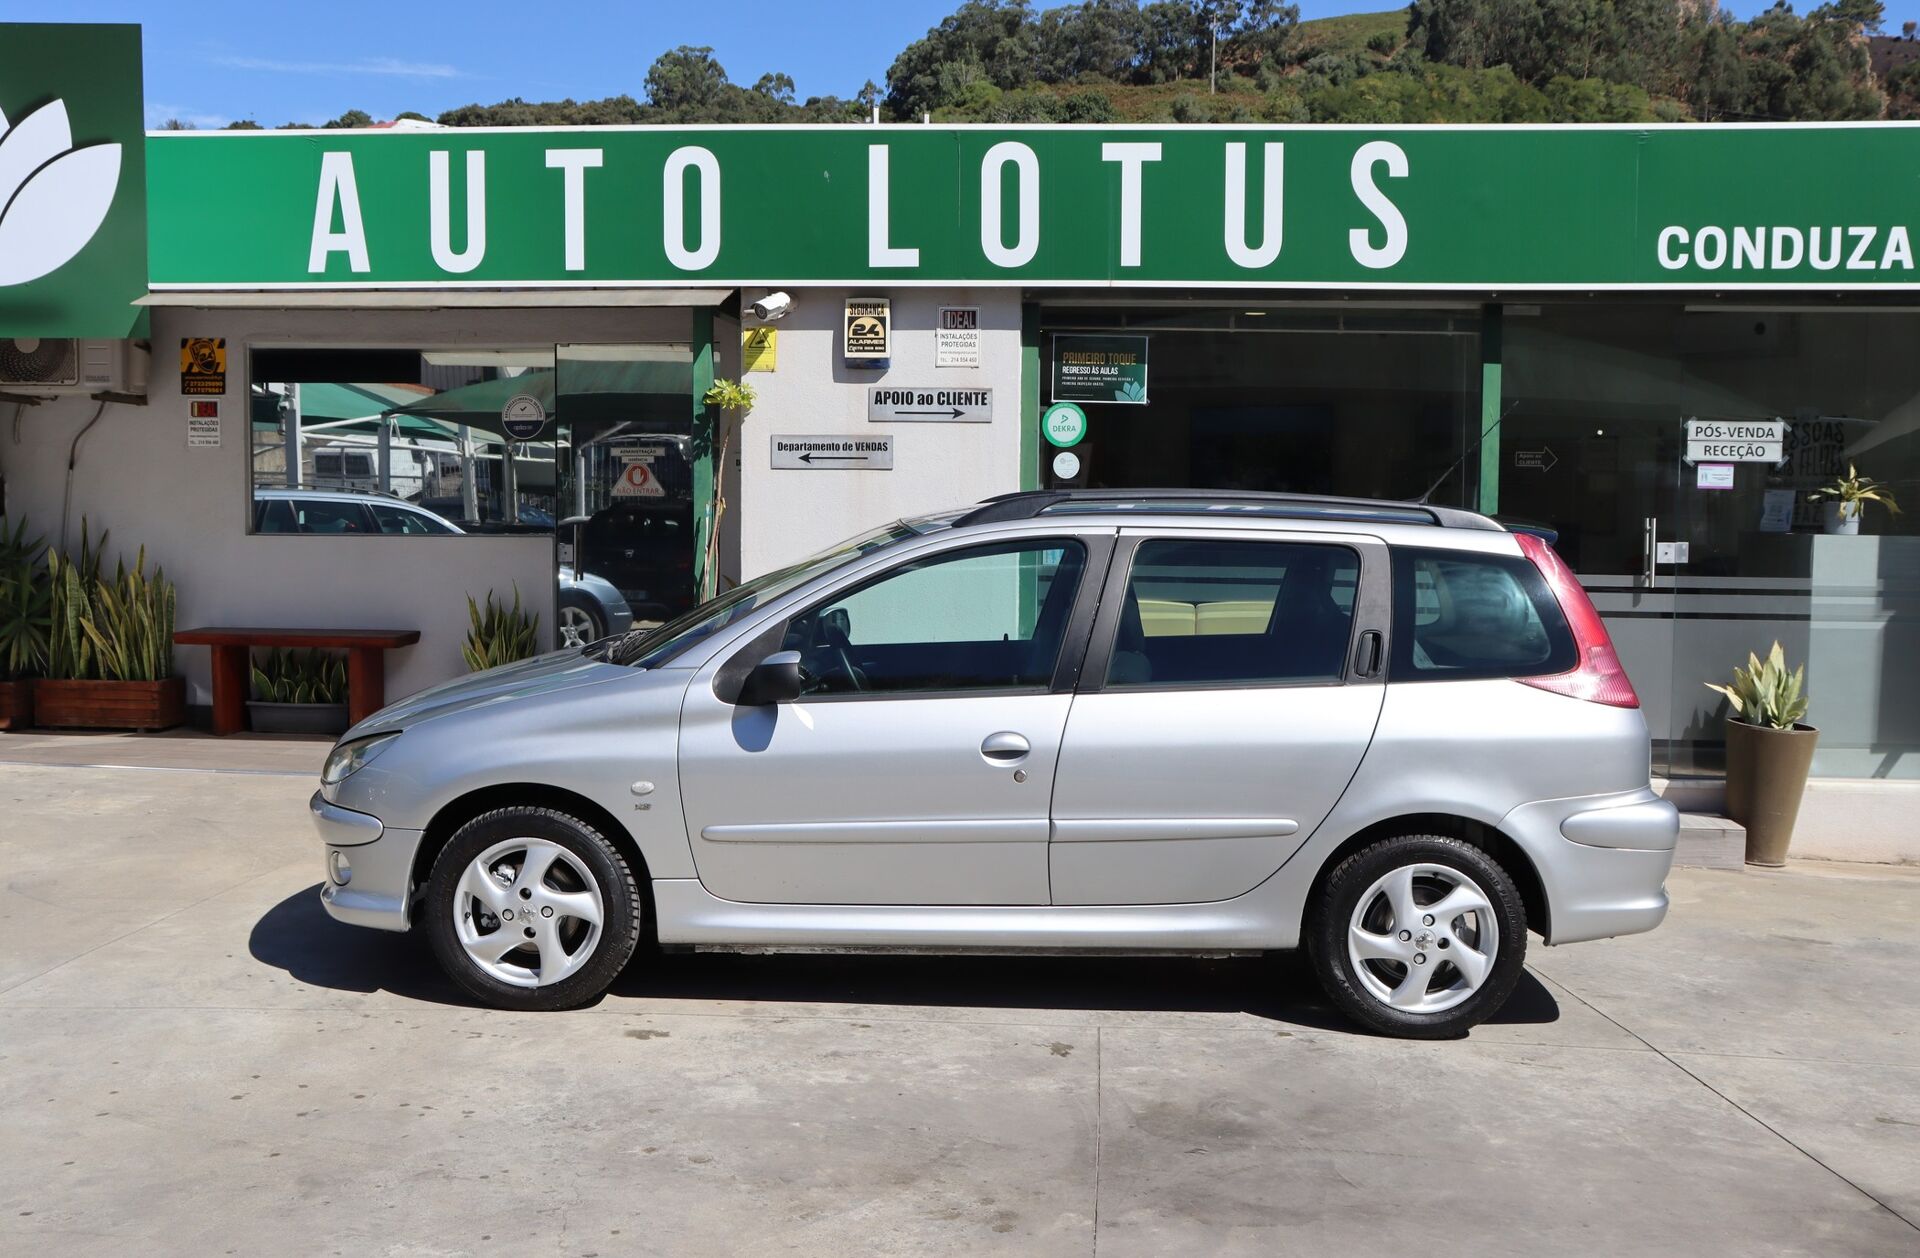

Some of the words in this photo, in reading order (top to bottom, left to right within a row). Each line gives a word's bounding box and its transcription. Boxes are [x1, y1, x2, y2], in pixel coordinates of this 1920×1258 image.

[307, 145, 722, 274] AUTO
[868, 141, 1410, 269] LOTUS
[1656, 224, 1914, 271] CONDUZA
[852, 323, 880, 336] 24
[940, 332, 978, 341] INSTALAÇÕES
[1062, 352, 1105, 365] PRIMEIRO
[1107, 353, 1137, 366] TOQUE
[1062, 366, 1091, 375] REGRESSO
[1091, 366, 1100, 375] ÀS
[1100, 367, 1119, 375] AULAS
[874, 390, 914, 406] APOIO
[917, 393, 934, 406] ao
[936, 391, 988, 406] CLIENTE
[1695, 424, 1775, 439] PÓS-VENDA
[777, 441, 841, 453] Departamento
[842, 441, 854, 452] de
[855, 441, 889, 452] VENDAS
[1703, 443, 1766, 460] RECEÇÃO
[616, 487, 632, 495] NÃO
